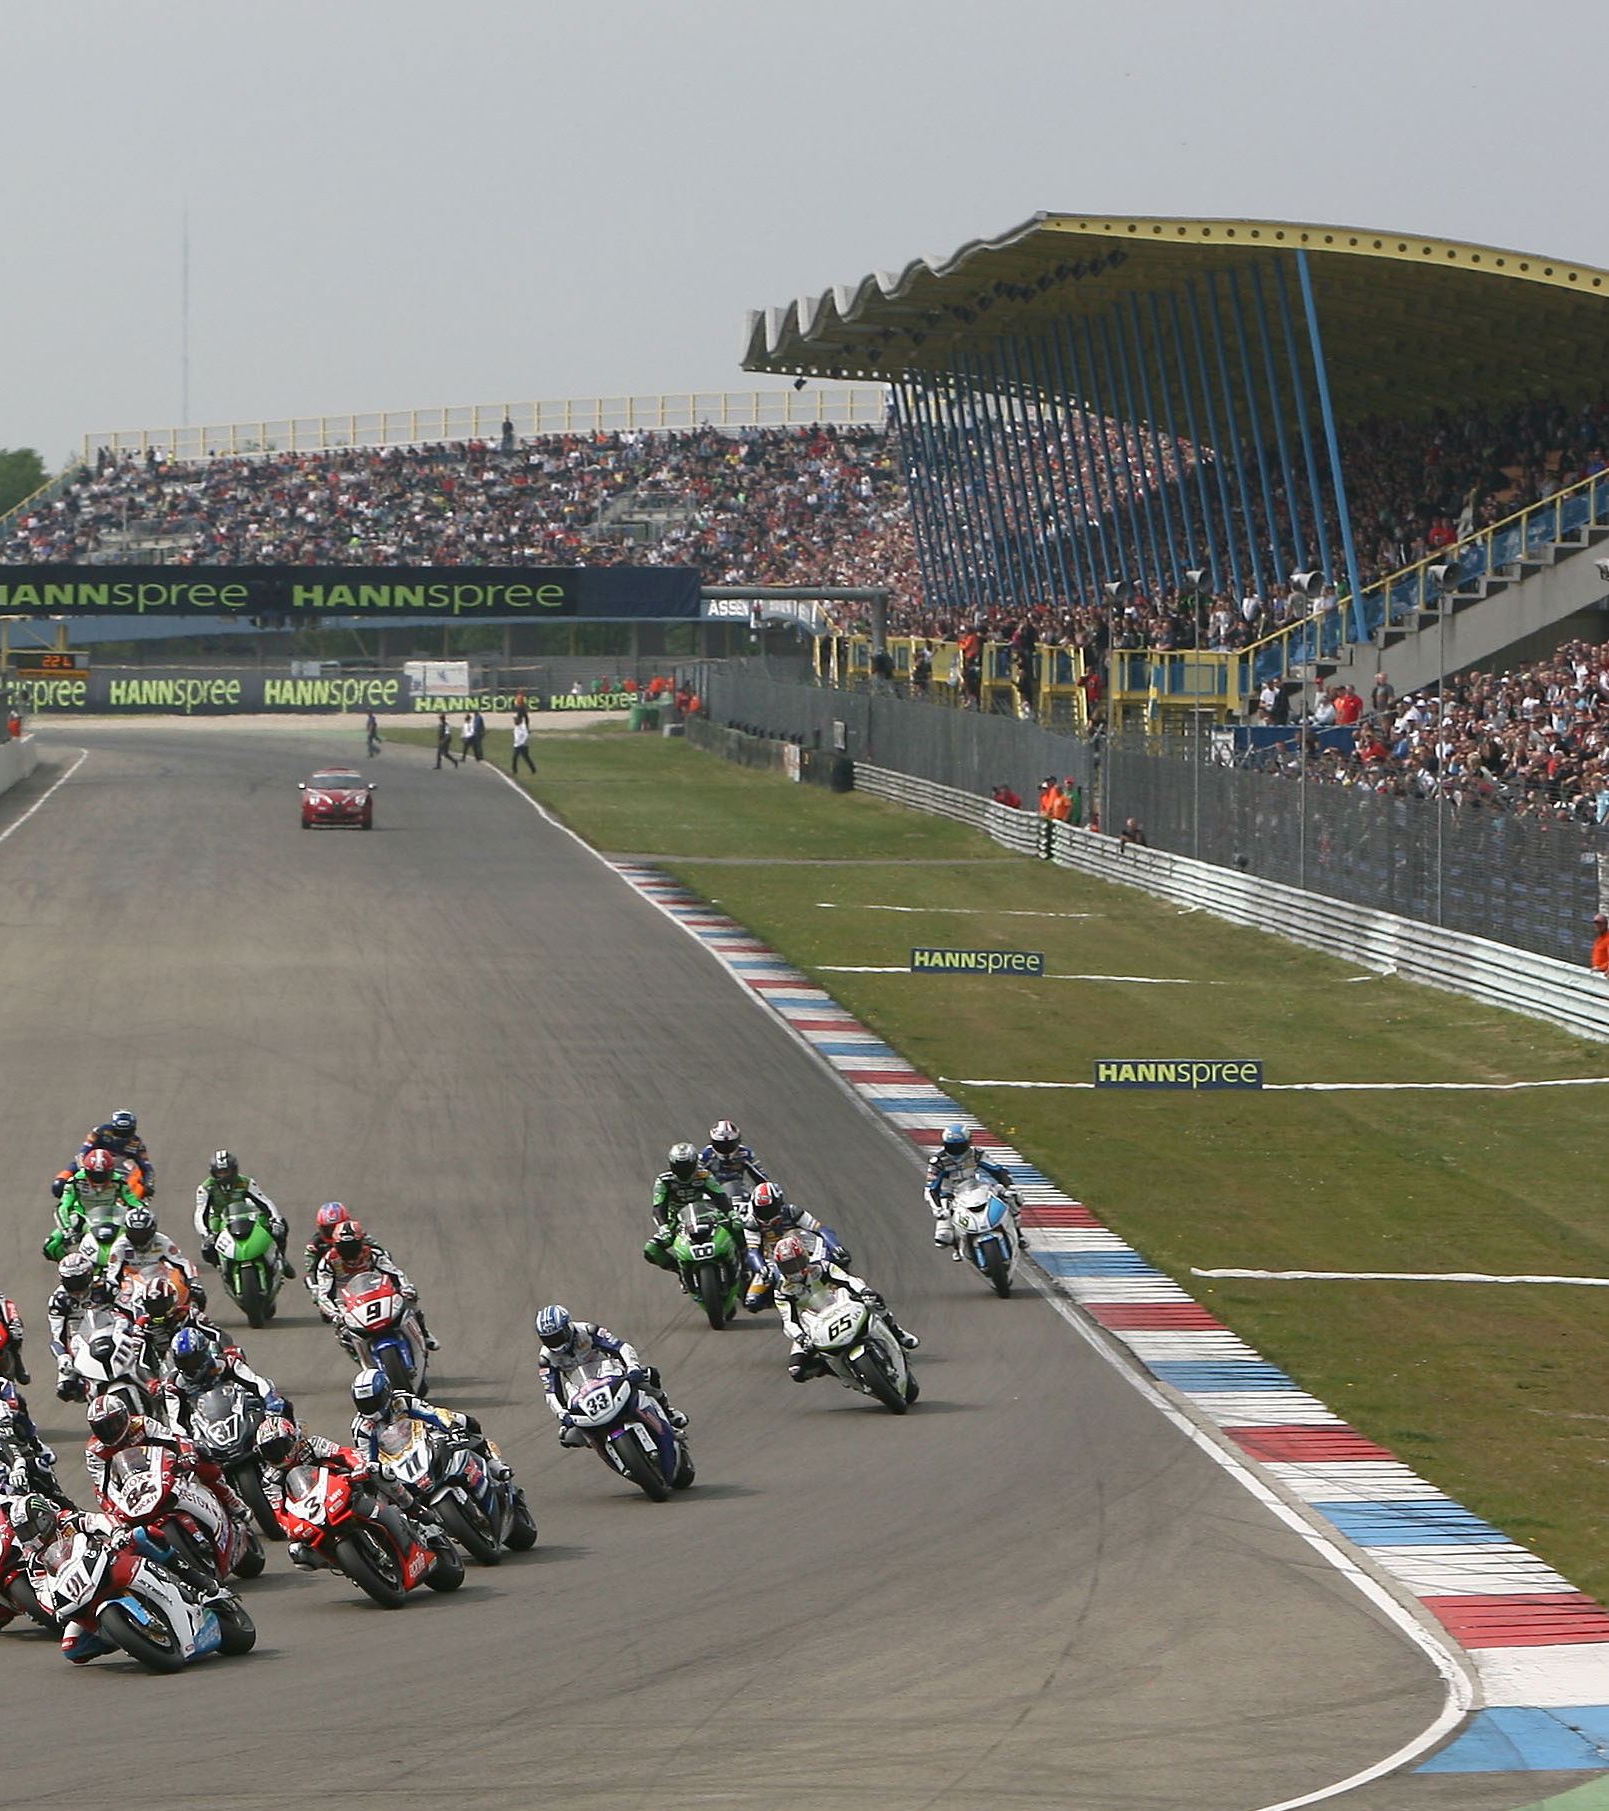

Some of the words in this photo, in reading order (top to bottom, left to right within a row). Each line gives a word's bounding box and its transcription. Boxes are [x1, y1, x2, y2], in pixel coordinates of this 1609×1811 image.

[292, 581, 565, 615] HANNspree
[109, 679, 241, 714] HANNspree
[264, 678, 400, 713] HANNspree
[414, 694, 540, 713] HANNspre
[550, 692, 639, 711] HANNspree
[913, 951, 1041, 974] HANNspree
[1098, 1062, 1259, 1089] HANNspree
[366, 1301, 381, 1323] 9
[828, 1313, 852, 1342] 65
[585, 1393, 610, 1416] 33
[303, 1495, 322, 1519] 3
[65, 1574, 88, 1597] 91
